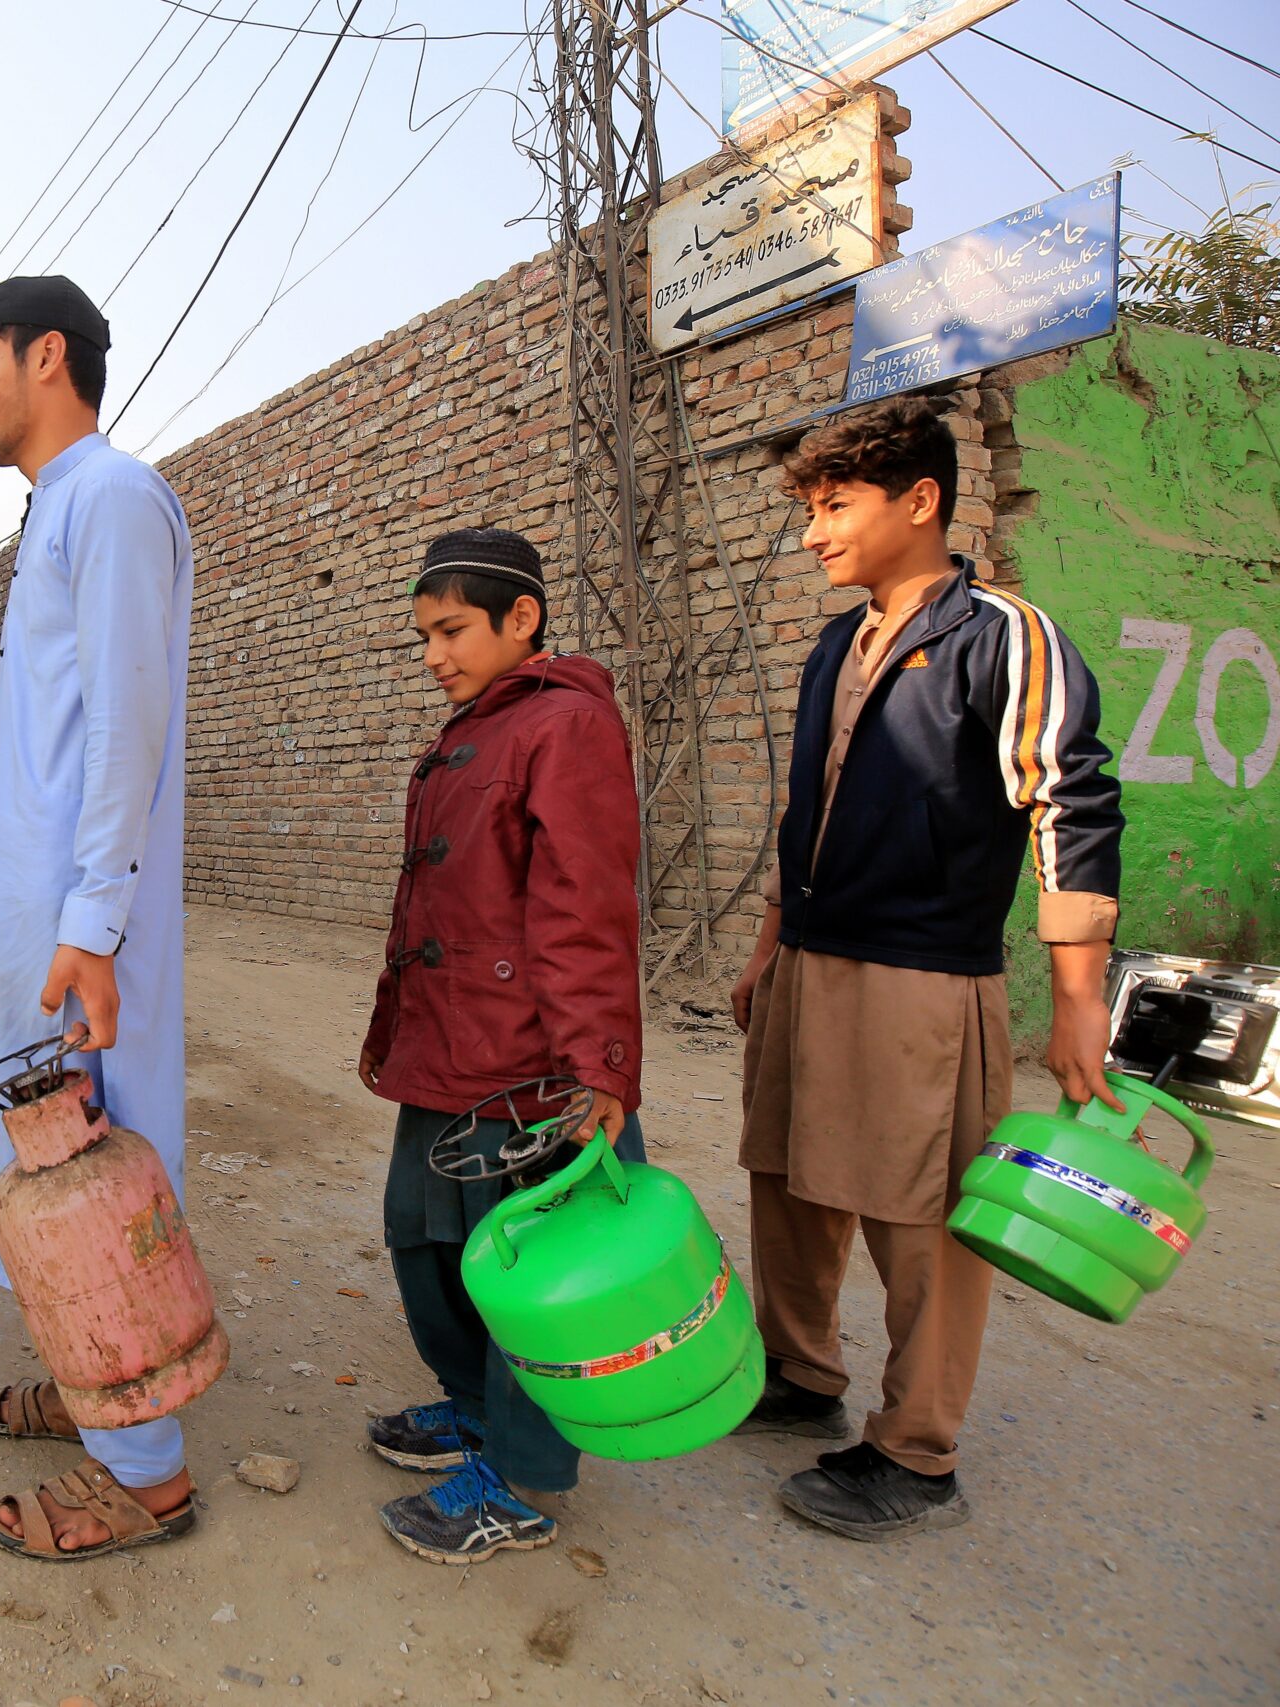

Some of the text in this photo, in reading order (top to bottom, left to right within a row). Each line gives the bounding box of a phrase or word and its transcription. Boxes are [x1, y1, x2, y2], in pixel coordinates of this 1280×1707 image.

[701, 162, 770, 207] مسجد
[771, 158, 860, 215] مسجد
[1038, 217, 1089, 257] جامع
[851, 343, 941, 385] 0321-9154974
[851, 360, 941, 401] 0311-9276133
[1118, 617, 1280, 789] ZO
[1119, 1199, 1153, 1226] LPG
